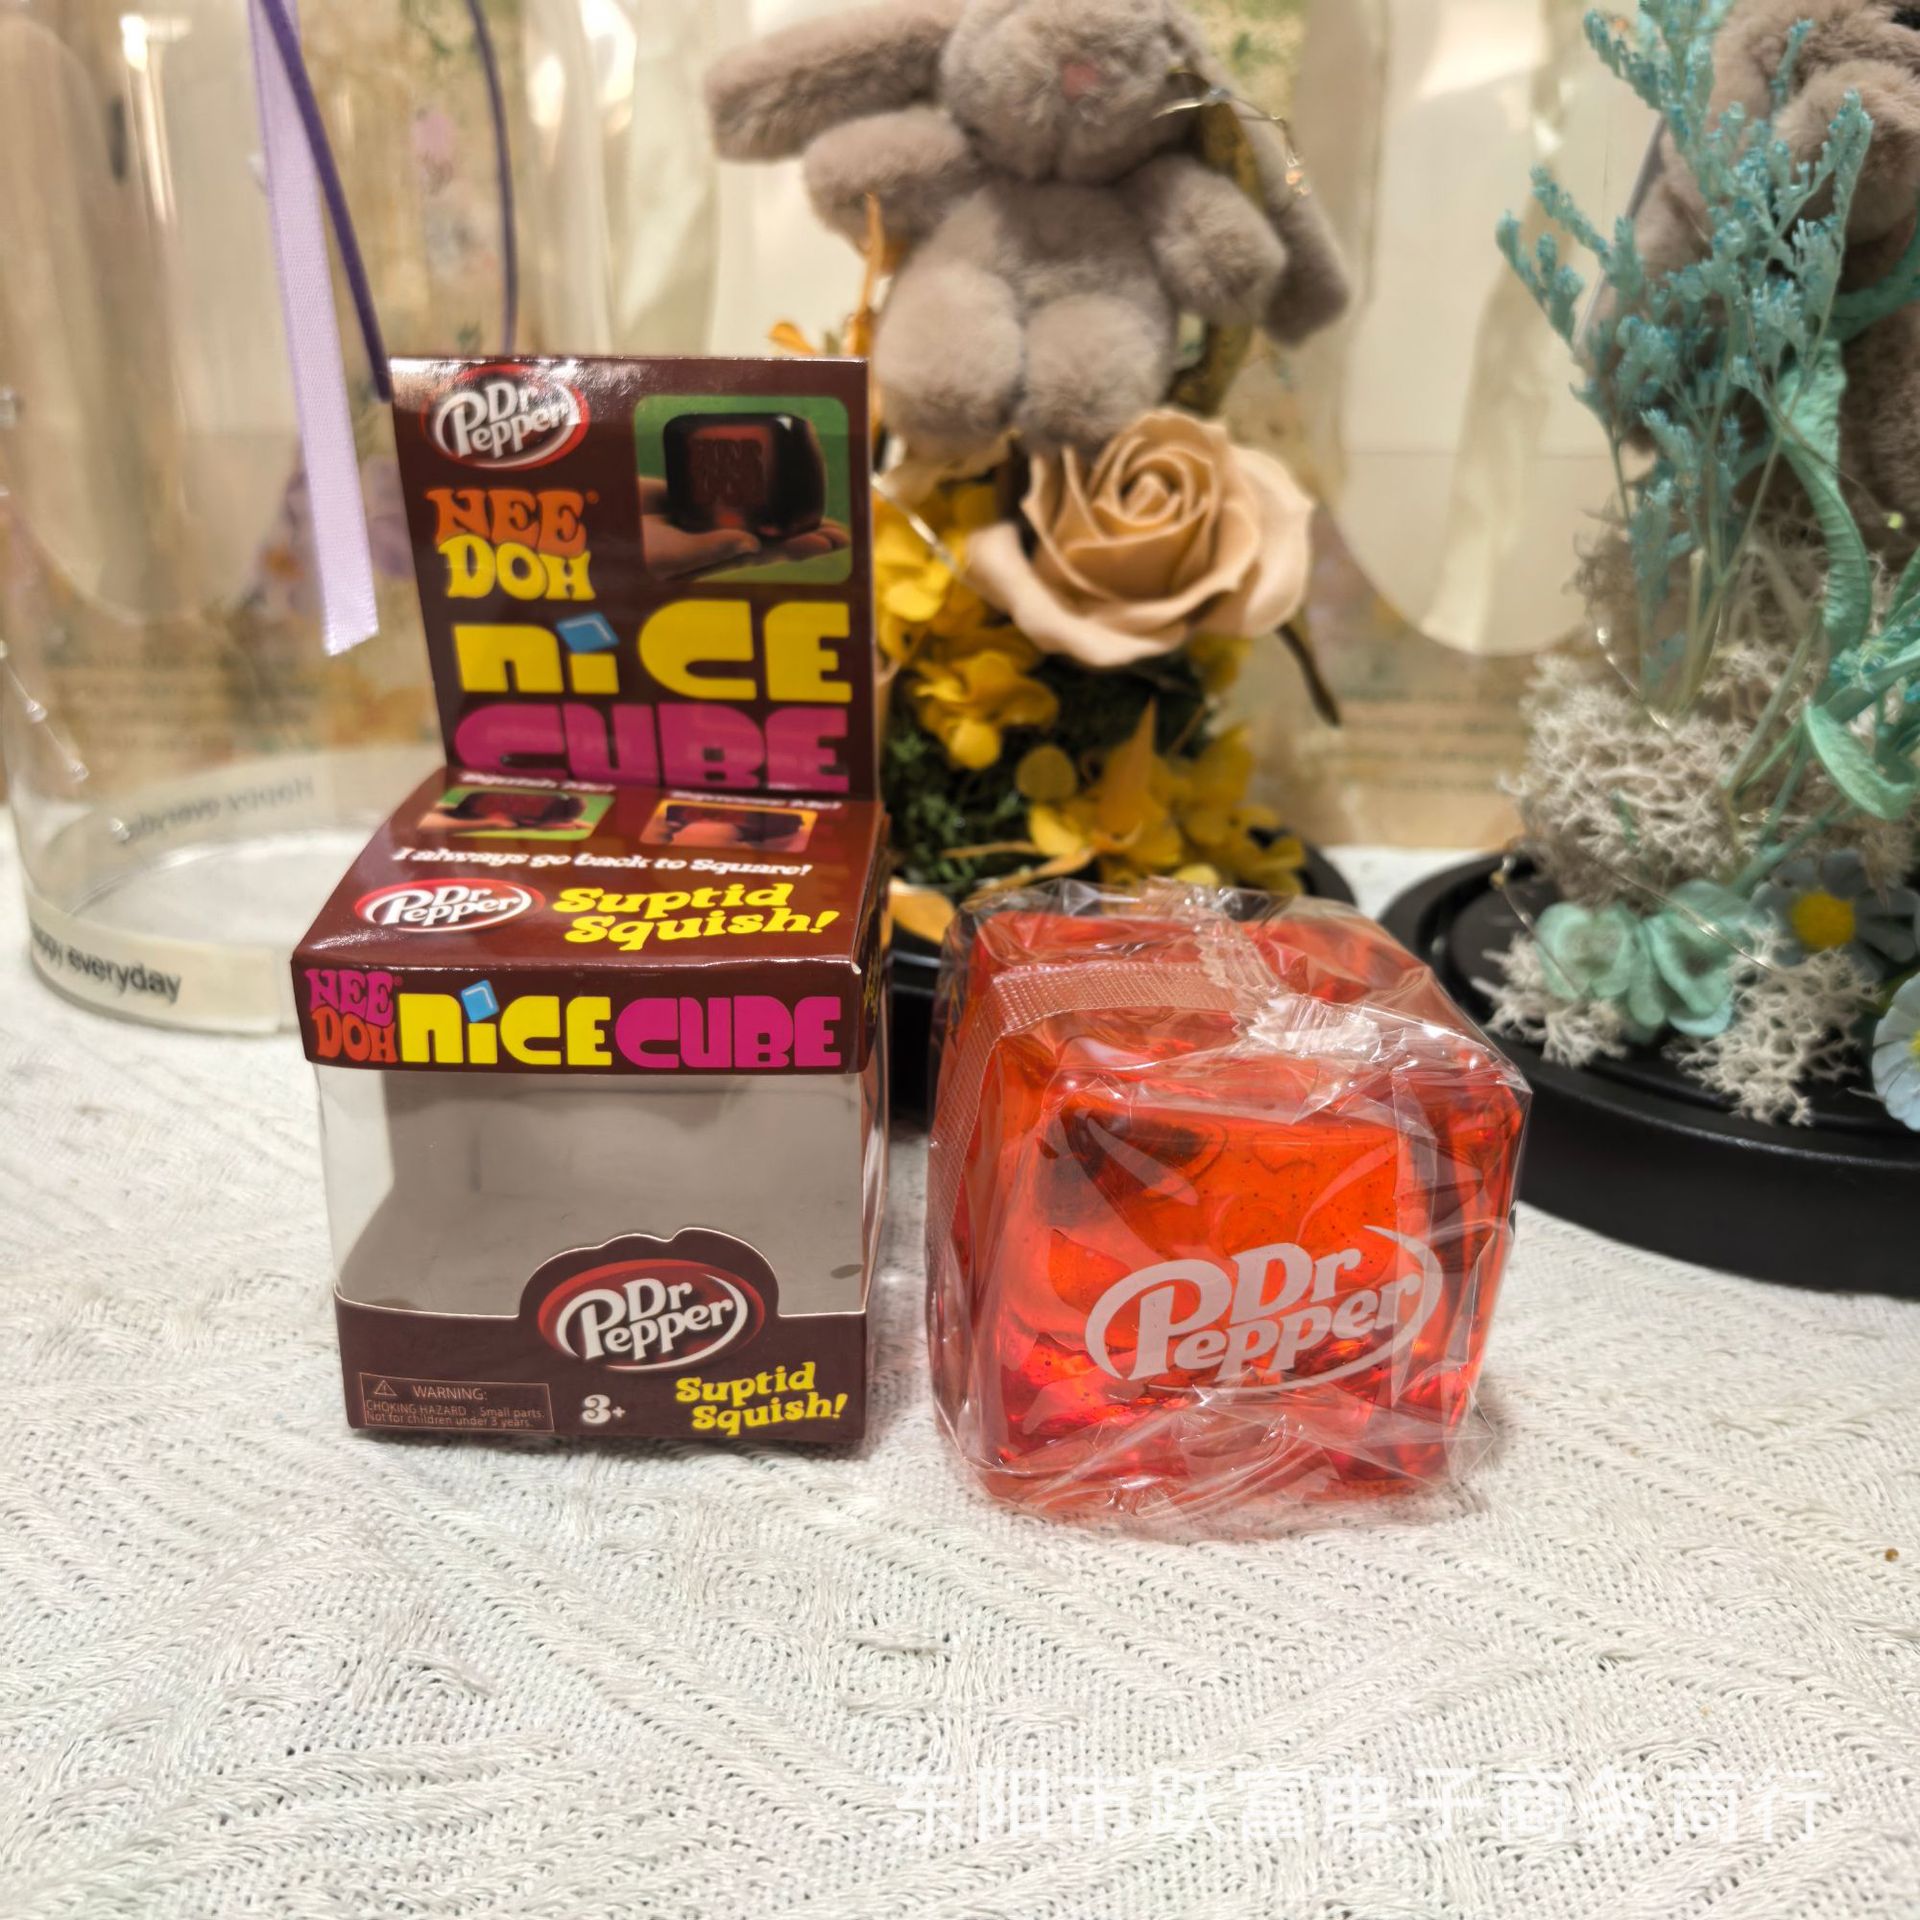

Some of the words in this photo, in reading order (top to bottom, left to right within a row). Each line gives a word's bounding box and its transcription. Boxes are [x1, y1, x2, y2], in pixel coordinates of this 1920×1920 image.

[485, 381, 538, 421] Dr
[435, 391, 569, 459] Pepper
[425, 488, 588, 558] NEE
[438, 534, 596, 600] DOH
[455, 702, 850, 793] CUBE
[392, 847, 416, 861] I
[411, 848, 530, 866] always
[529, 853, 571, 868] go
[573, 853, 653, 869] back
[653, 857, 688, 870] to
[690, 858, 813, 876] Square!
[366, 889, 521, 926] Pepper
[428, 885, 491, 906] Dr
[552, 883, 794, 918] Suptid
[564, 908, 840, 951] Squish!
[66, 945, 182, 1005] everyday
[304, 968, 395, 1028] NEE
[312, 1005, 399, 1064] DOH
[615, 995, 842, 1069] CUBE
[621, 1278, 693, 1320] Dr
[1230, 1242, 1362, 1325] Dr
[556, 1288, 735, 1361] Pepper
[1085, 1258, 1422, 1382] Pepper
[412, 1385, 488, 1401] WARNING:
[675, 1361, 815, 1403] Suptid
[366, 1400, 417, 1415] CHOKING
[420, 1404, 467, 1417] HAZARD
[480, 1406, 510, 1418] Small
[366, 1411, 386, 1422] Not
[389, 1412, 404, 1423] for
[408, 1413, 451, 1425] children
[456, 1415, 488, 1426] under
[491, 1416, 498, 1426] 3
[581, 1394, 626, 1425] 3+
[691, 1393, 848, 1436] Squish!
